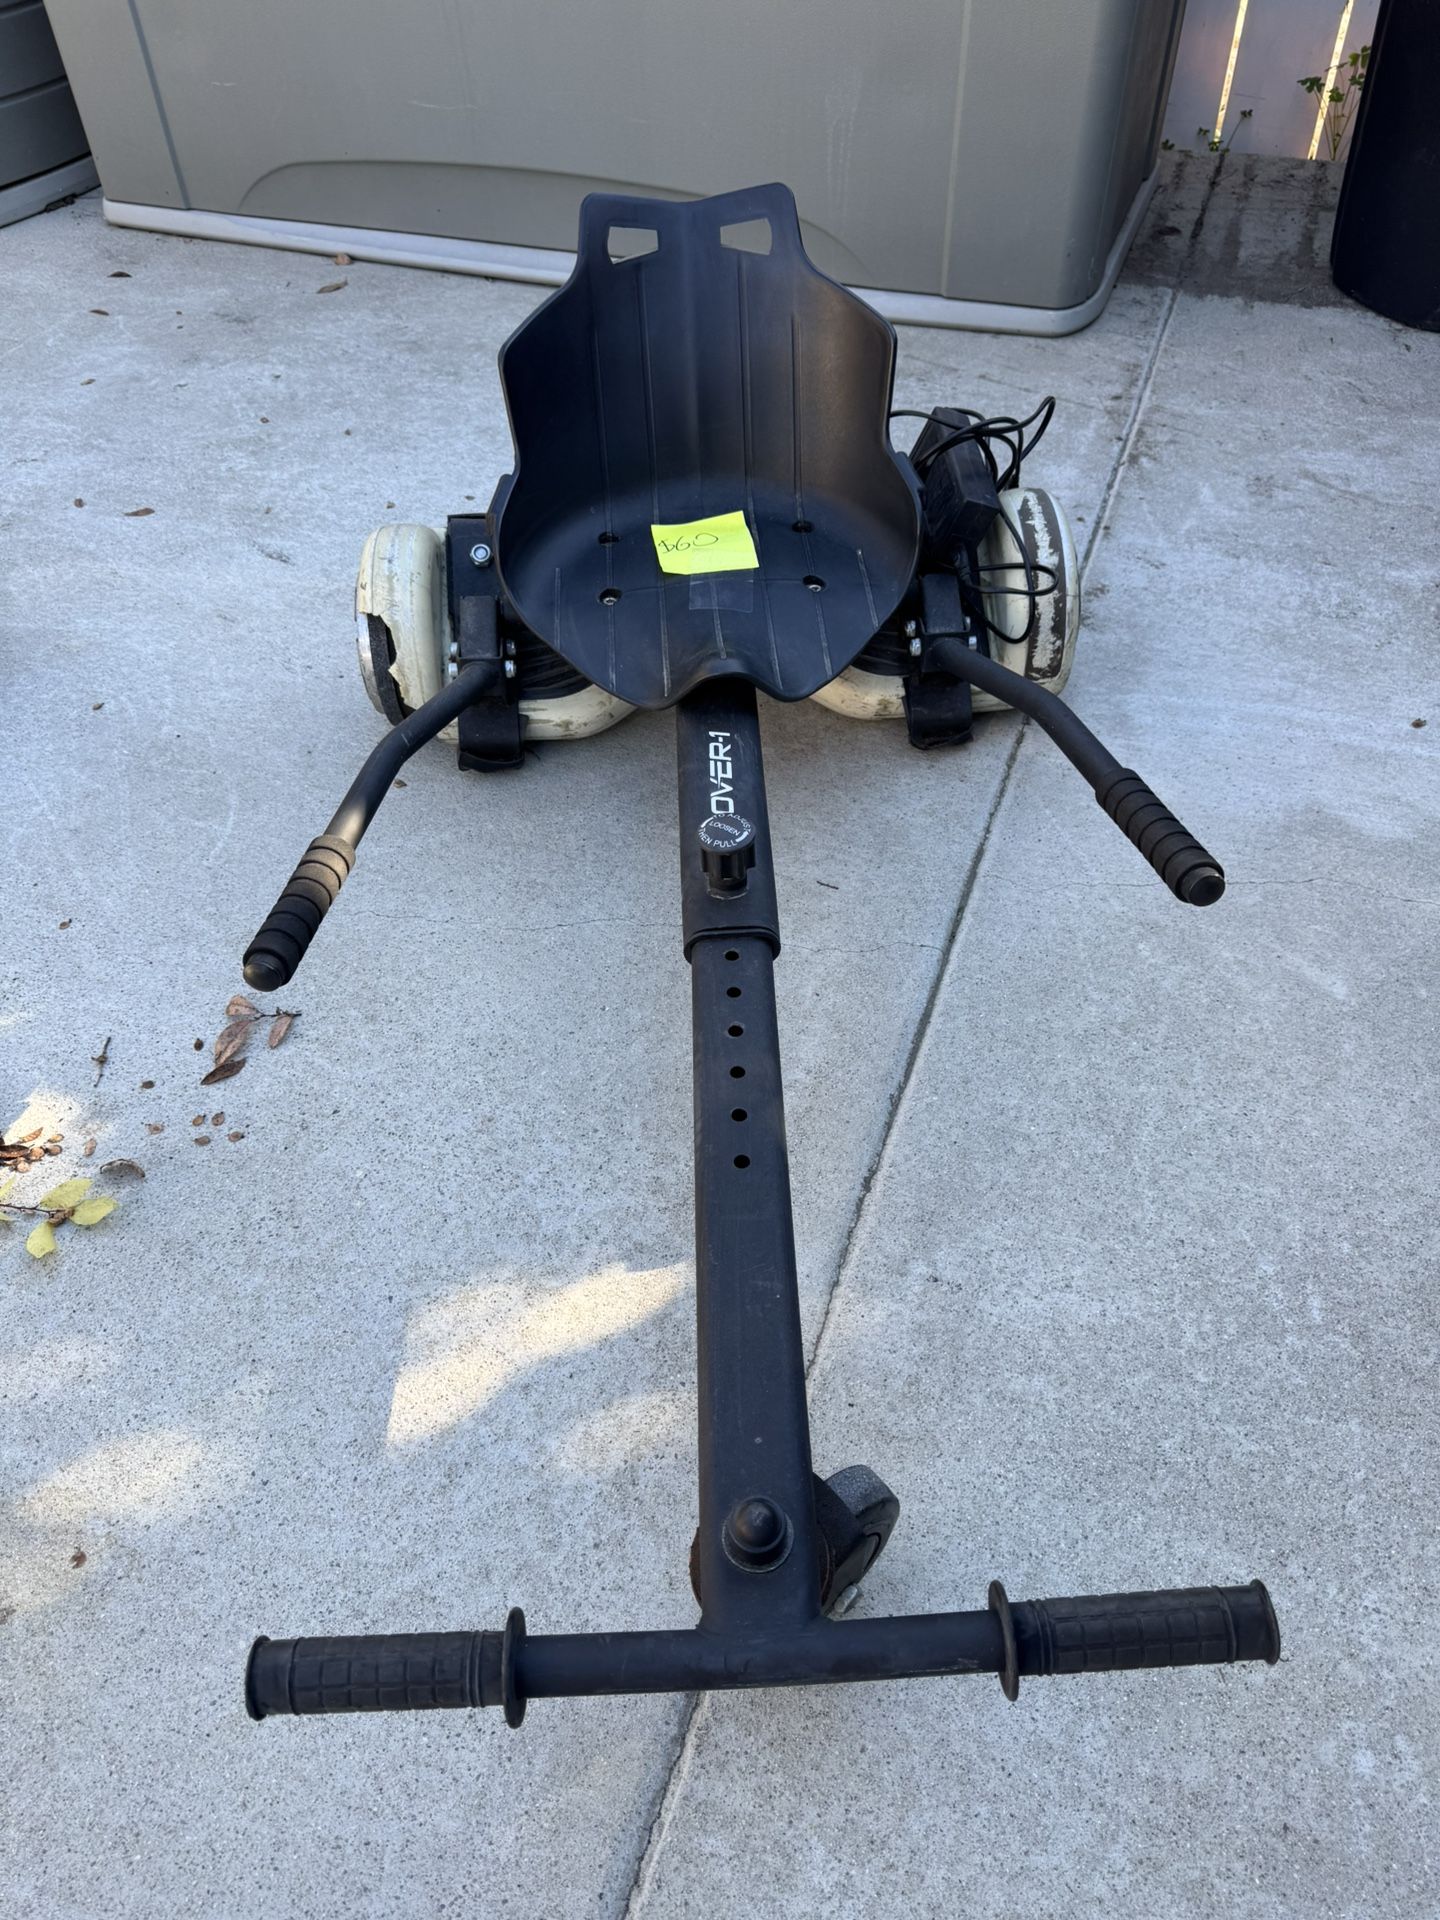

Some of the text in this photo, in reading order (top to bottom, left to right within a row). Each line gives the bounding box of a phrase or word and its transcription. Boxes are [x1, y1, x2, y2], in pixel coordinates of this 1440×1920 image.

[658, 532, 719, 554] $60
[709, 731, 734, 814] OVER-1
[698, 828, 737, 848] THEN PULL
[709, 820, 741, 836] LOOSEN
